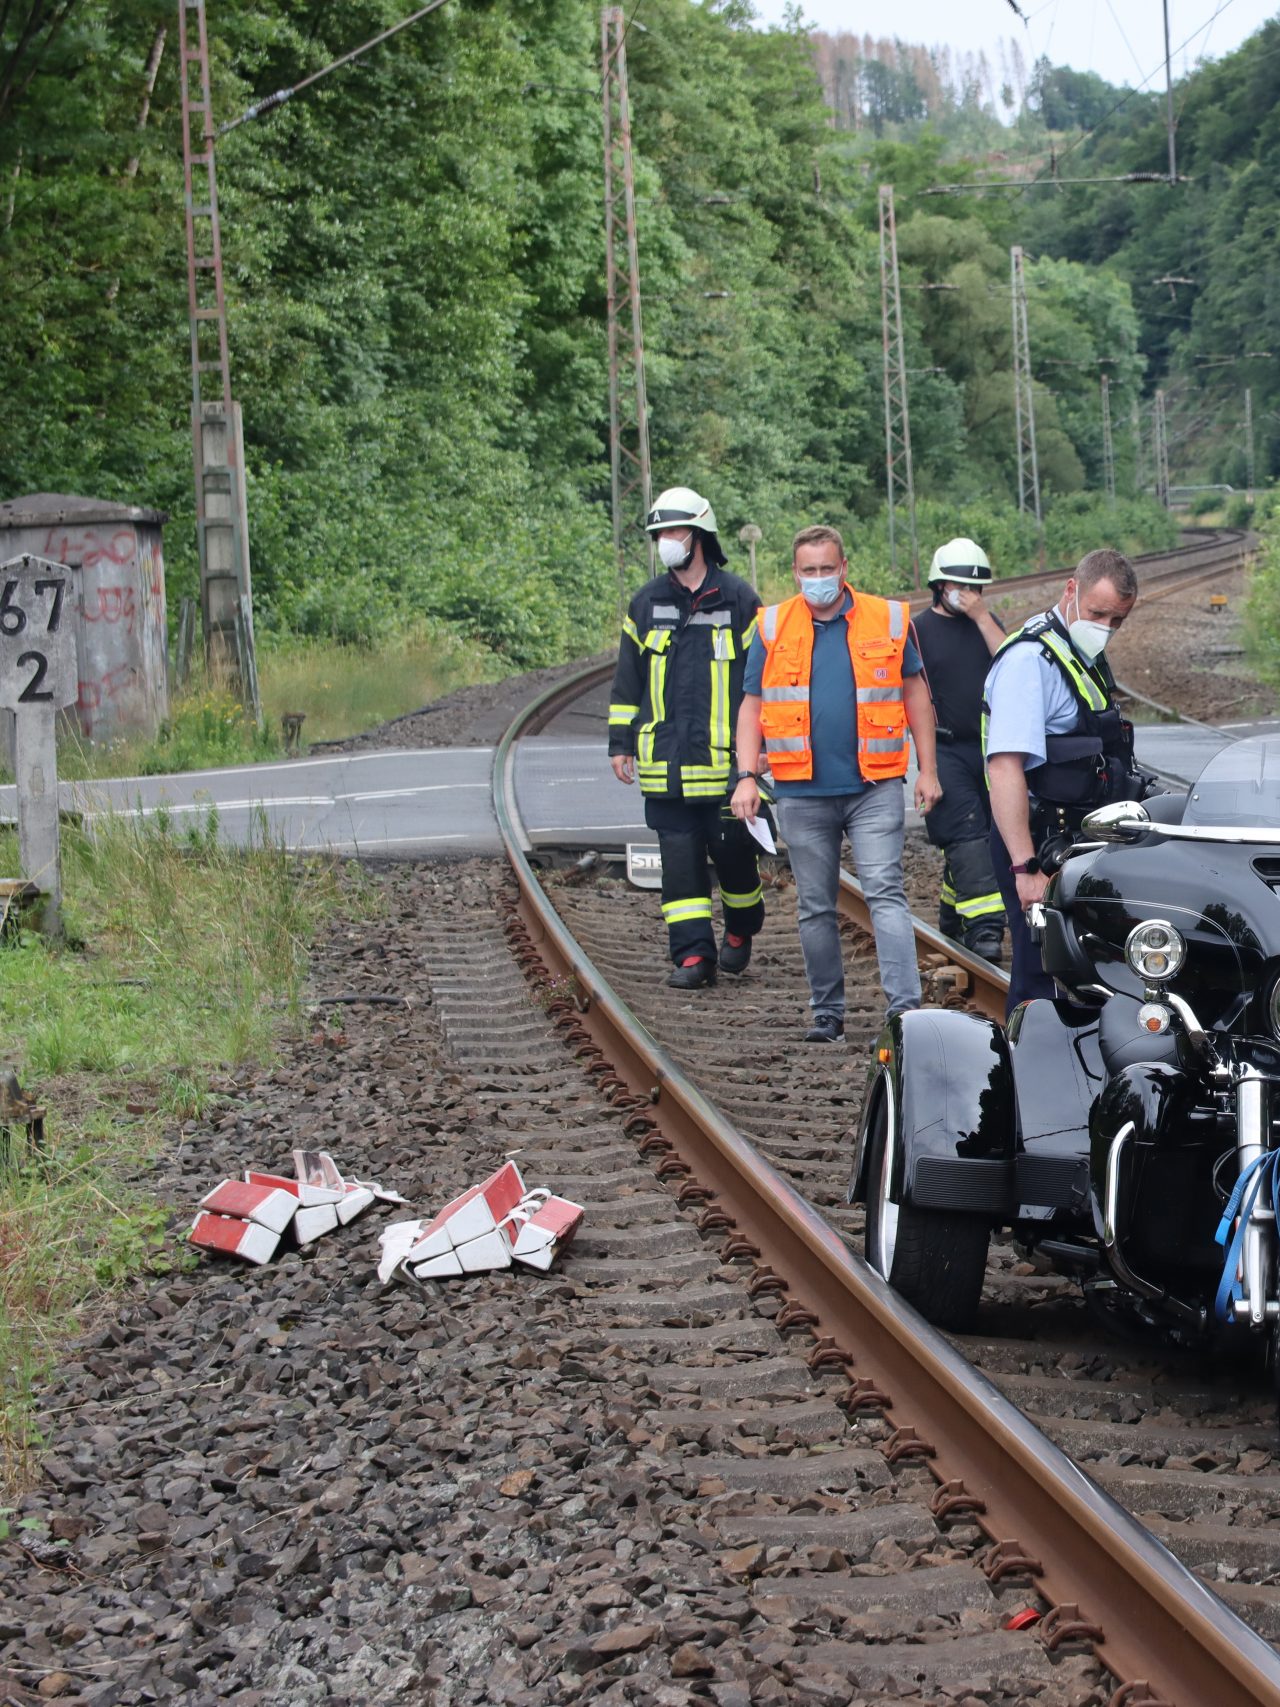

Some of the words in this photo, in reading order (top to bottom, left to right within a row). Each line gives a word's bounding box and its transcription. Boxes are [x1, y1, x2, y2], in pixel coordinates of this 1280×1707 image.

[653, 510, 661, 523] A
[972, 565, 979, 577] A
[0, 578, 66, 636] 67
[17, 650, 54, 703] 2
